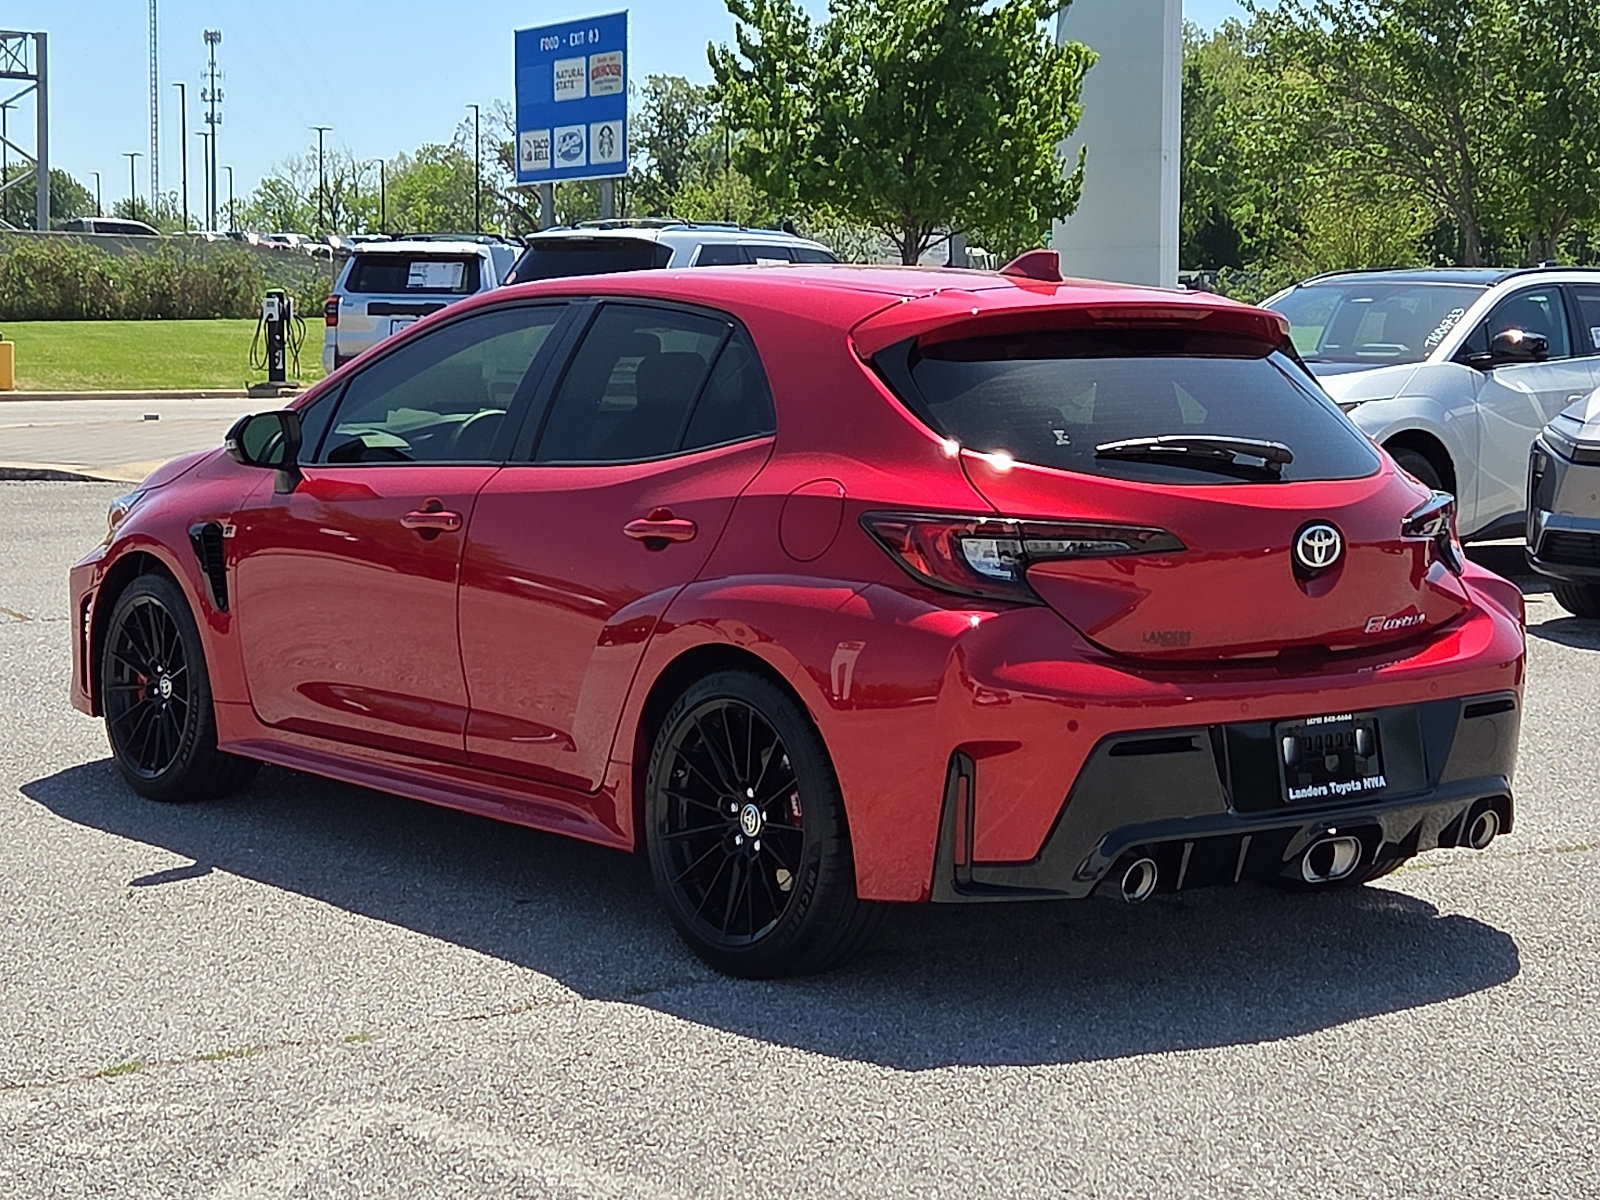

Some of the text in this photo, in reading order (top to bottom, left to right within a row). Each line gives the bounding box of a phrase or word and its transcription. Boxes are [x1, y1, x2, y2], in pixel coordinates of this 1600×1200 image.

[540, 35, 560, 51] FOOD
[569, 31, 585, 48] EXIT
[556, 67, 585, 79] NATURAL
[556, 80, 575, 91] STATE
[533, 138, 549, 150] TACO
[533, 149, 549, 162] BELL
[1288, 775, 1387, 800] Landers Toyota NWA
